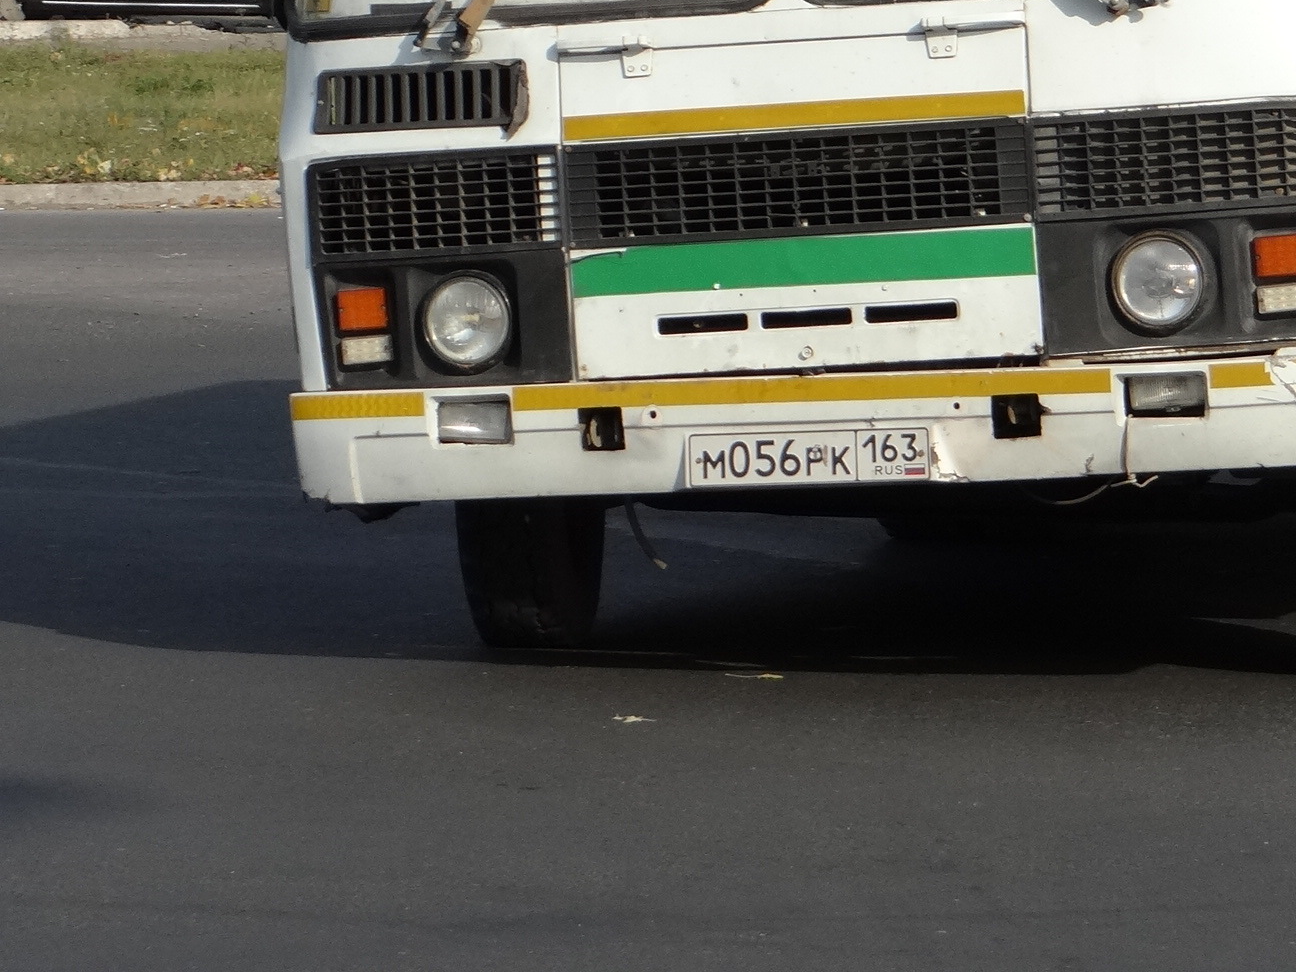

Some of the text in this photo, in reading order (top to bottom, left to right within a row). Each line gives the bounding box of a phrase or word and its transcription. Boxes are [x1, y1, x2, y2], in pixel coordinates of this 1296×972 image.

[702, 433, 918, 479] М056РК 163
[874, 464, 904, 476] RUS
